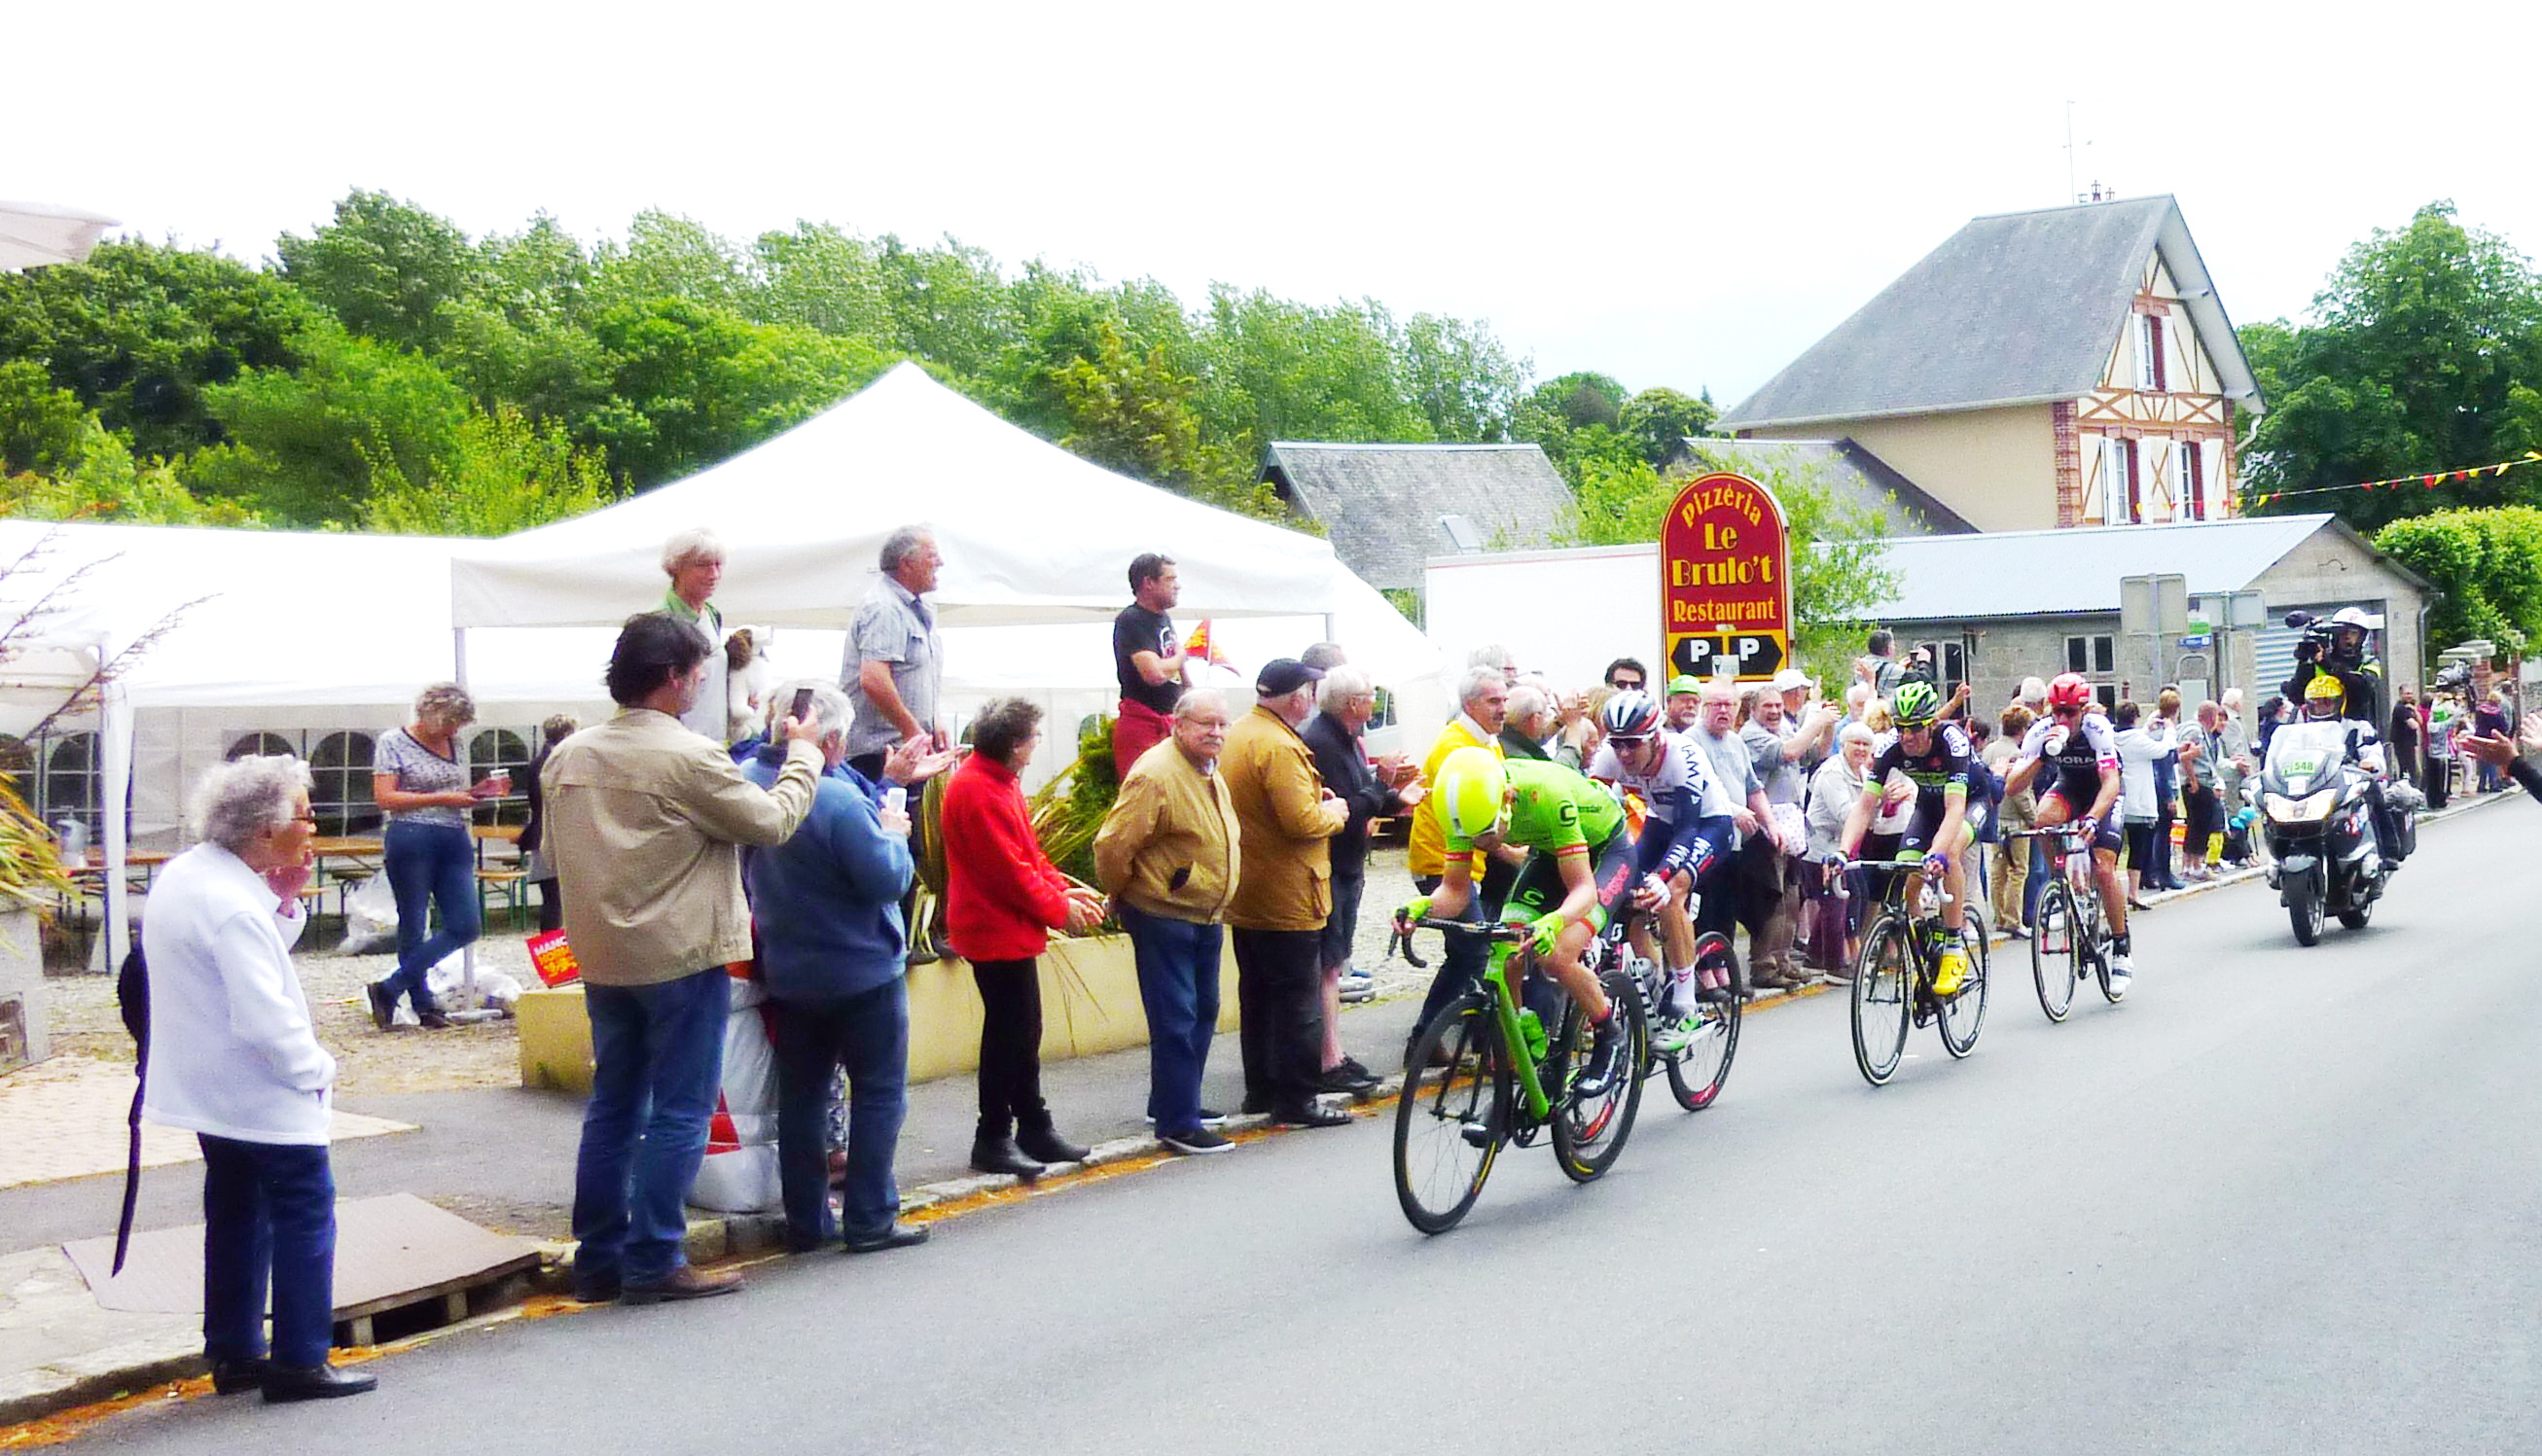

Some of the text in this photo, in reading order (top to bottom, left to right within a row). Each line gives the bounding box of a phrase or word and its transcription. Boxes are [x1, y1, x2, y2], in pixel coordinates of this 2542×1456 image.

[1704, 523, 1738, 550] Le
[1672, 555, 1775, 587] Brulo't
[1673, 597, 1776, 622] Restaurant
[1690, 638, 1760, 662] P P
[1681, 743, 1701, 779] IAM
[2294, 761, 2313, 771] 548
